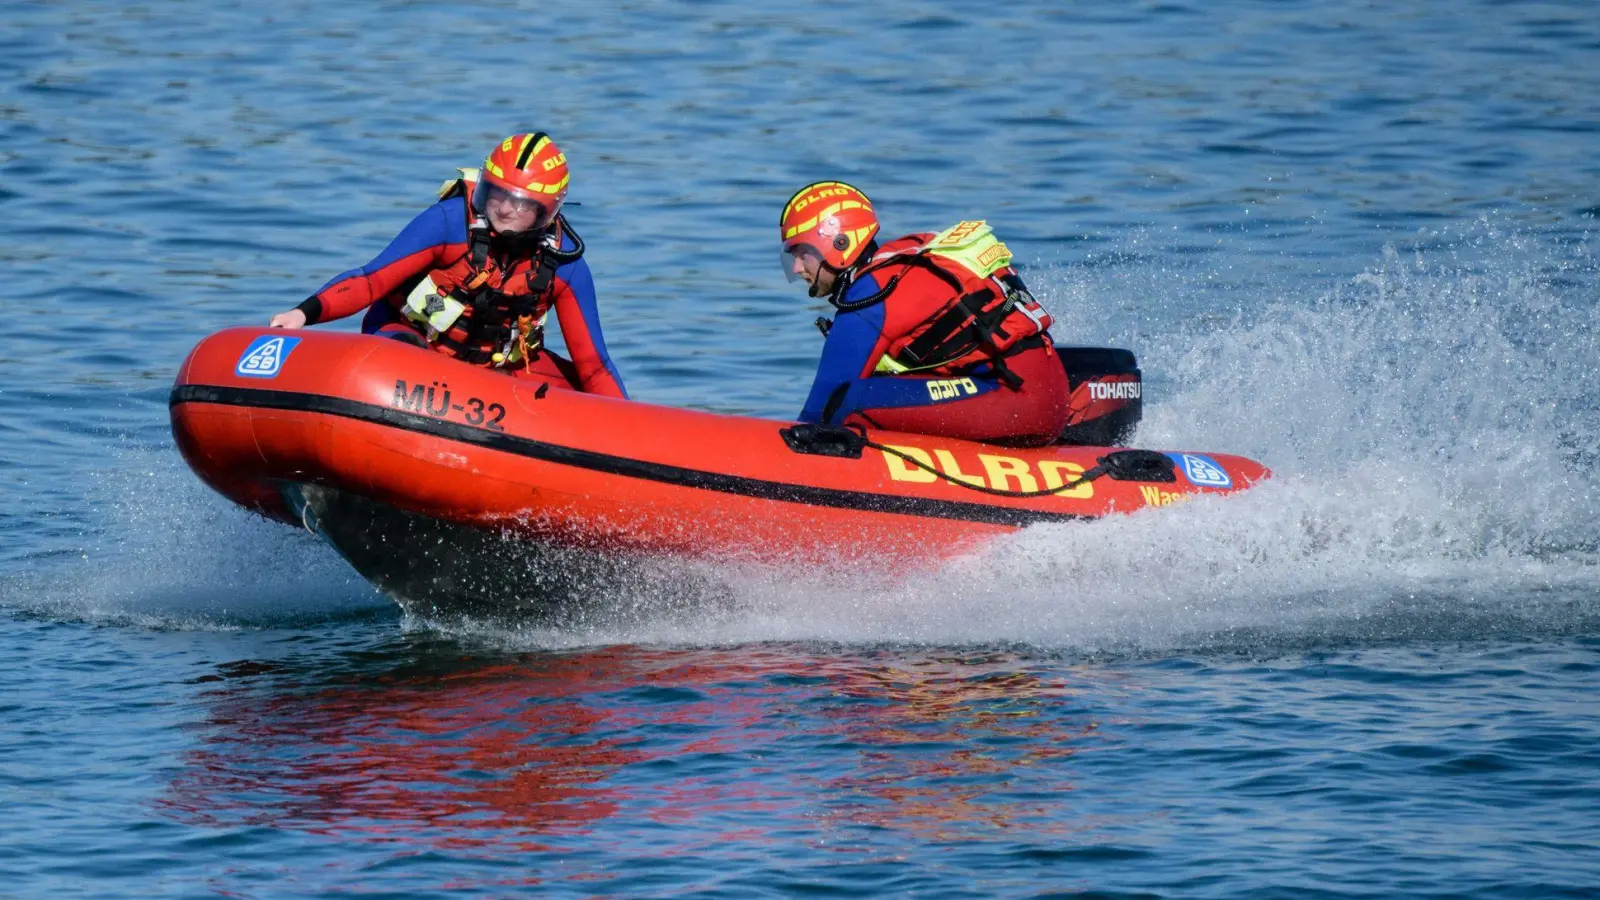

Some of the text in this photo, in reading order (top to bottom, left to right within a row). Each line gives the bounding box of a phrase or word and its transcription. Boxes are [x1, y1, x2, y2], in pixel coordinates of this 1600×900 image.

[795, 188, 848, 212] DLRG
[392, 379, 506, 431] MÜ-32
[1088, 382, 1140, 399] TOHATSU
[882, 445, 1094, 498] DLRG
